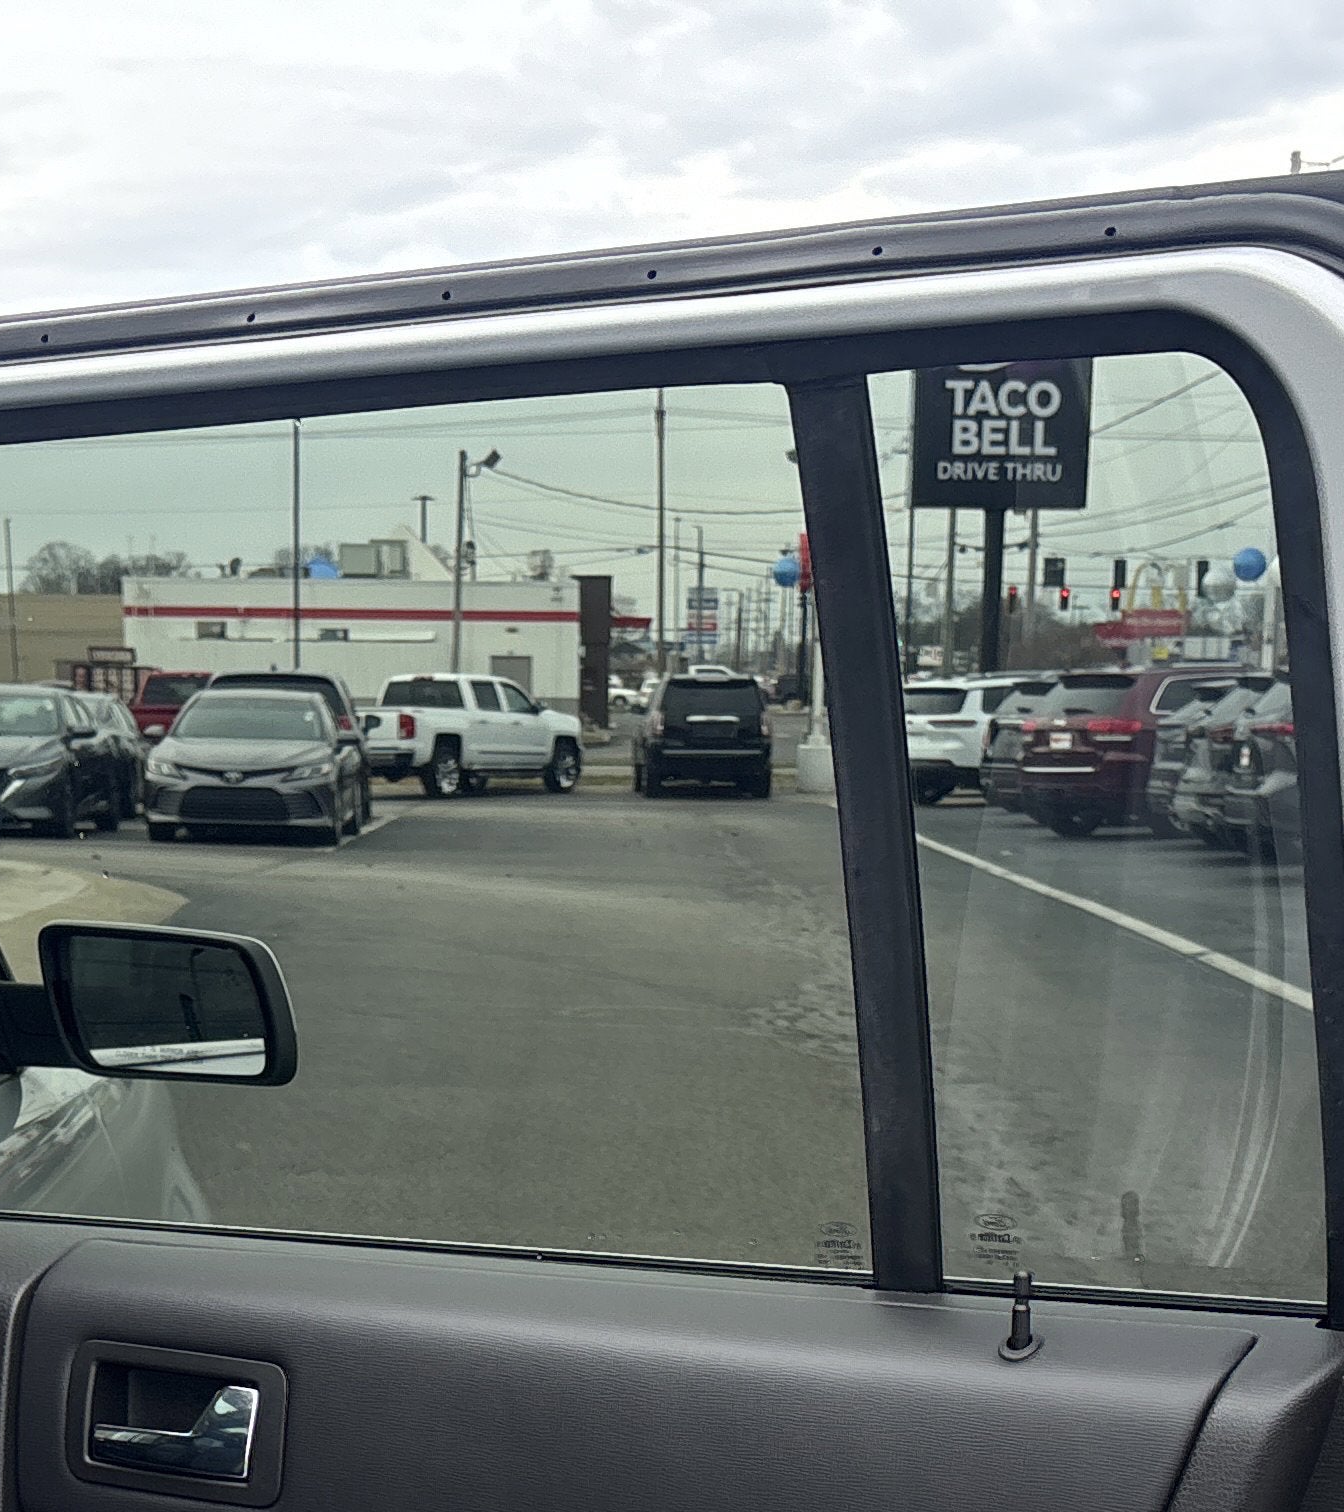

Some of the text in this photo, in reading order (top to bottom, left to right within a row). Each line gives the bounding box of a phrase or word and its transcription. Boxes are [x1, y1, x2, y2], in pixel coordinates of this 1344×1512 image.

[944, 379, 1062, 418] TACO
[951, 418, 1058, 456] BELL
[936, 461, 1063, 482] DRIVE THRU
